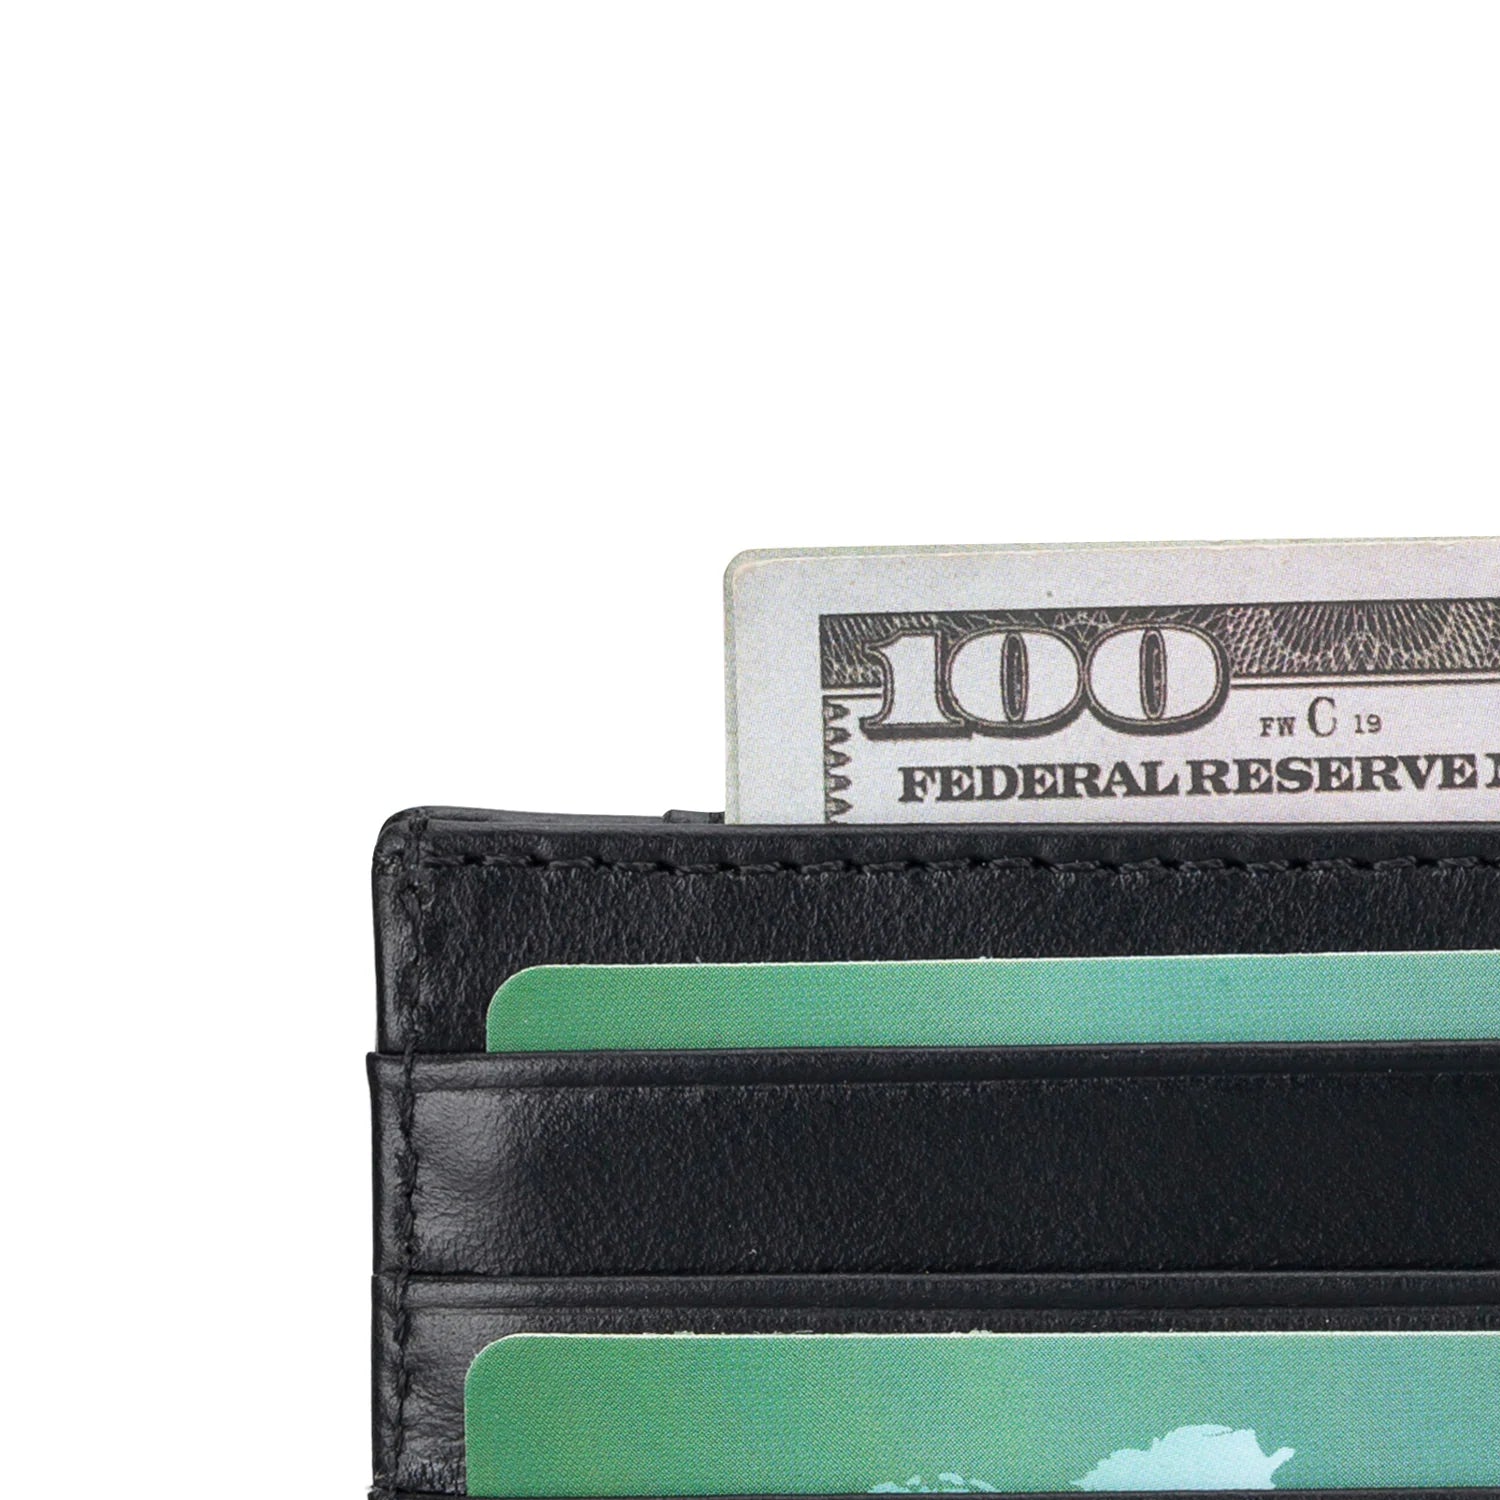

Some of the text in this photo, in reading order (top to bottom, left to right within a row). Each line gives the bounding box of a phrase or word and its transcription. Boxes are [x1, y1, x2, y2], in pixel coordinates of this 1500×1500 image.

[859, 623, 1231, 739] 100
[1307, 696, 1337, 737] C
[1354, 713, 1382, 734] 19
[898, 757, 1179, 802] FEDERAL
[1185, 753, 1478, 797] RESERVE
